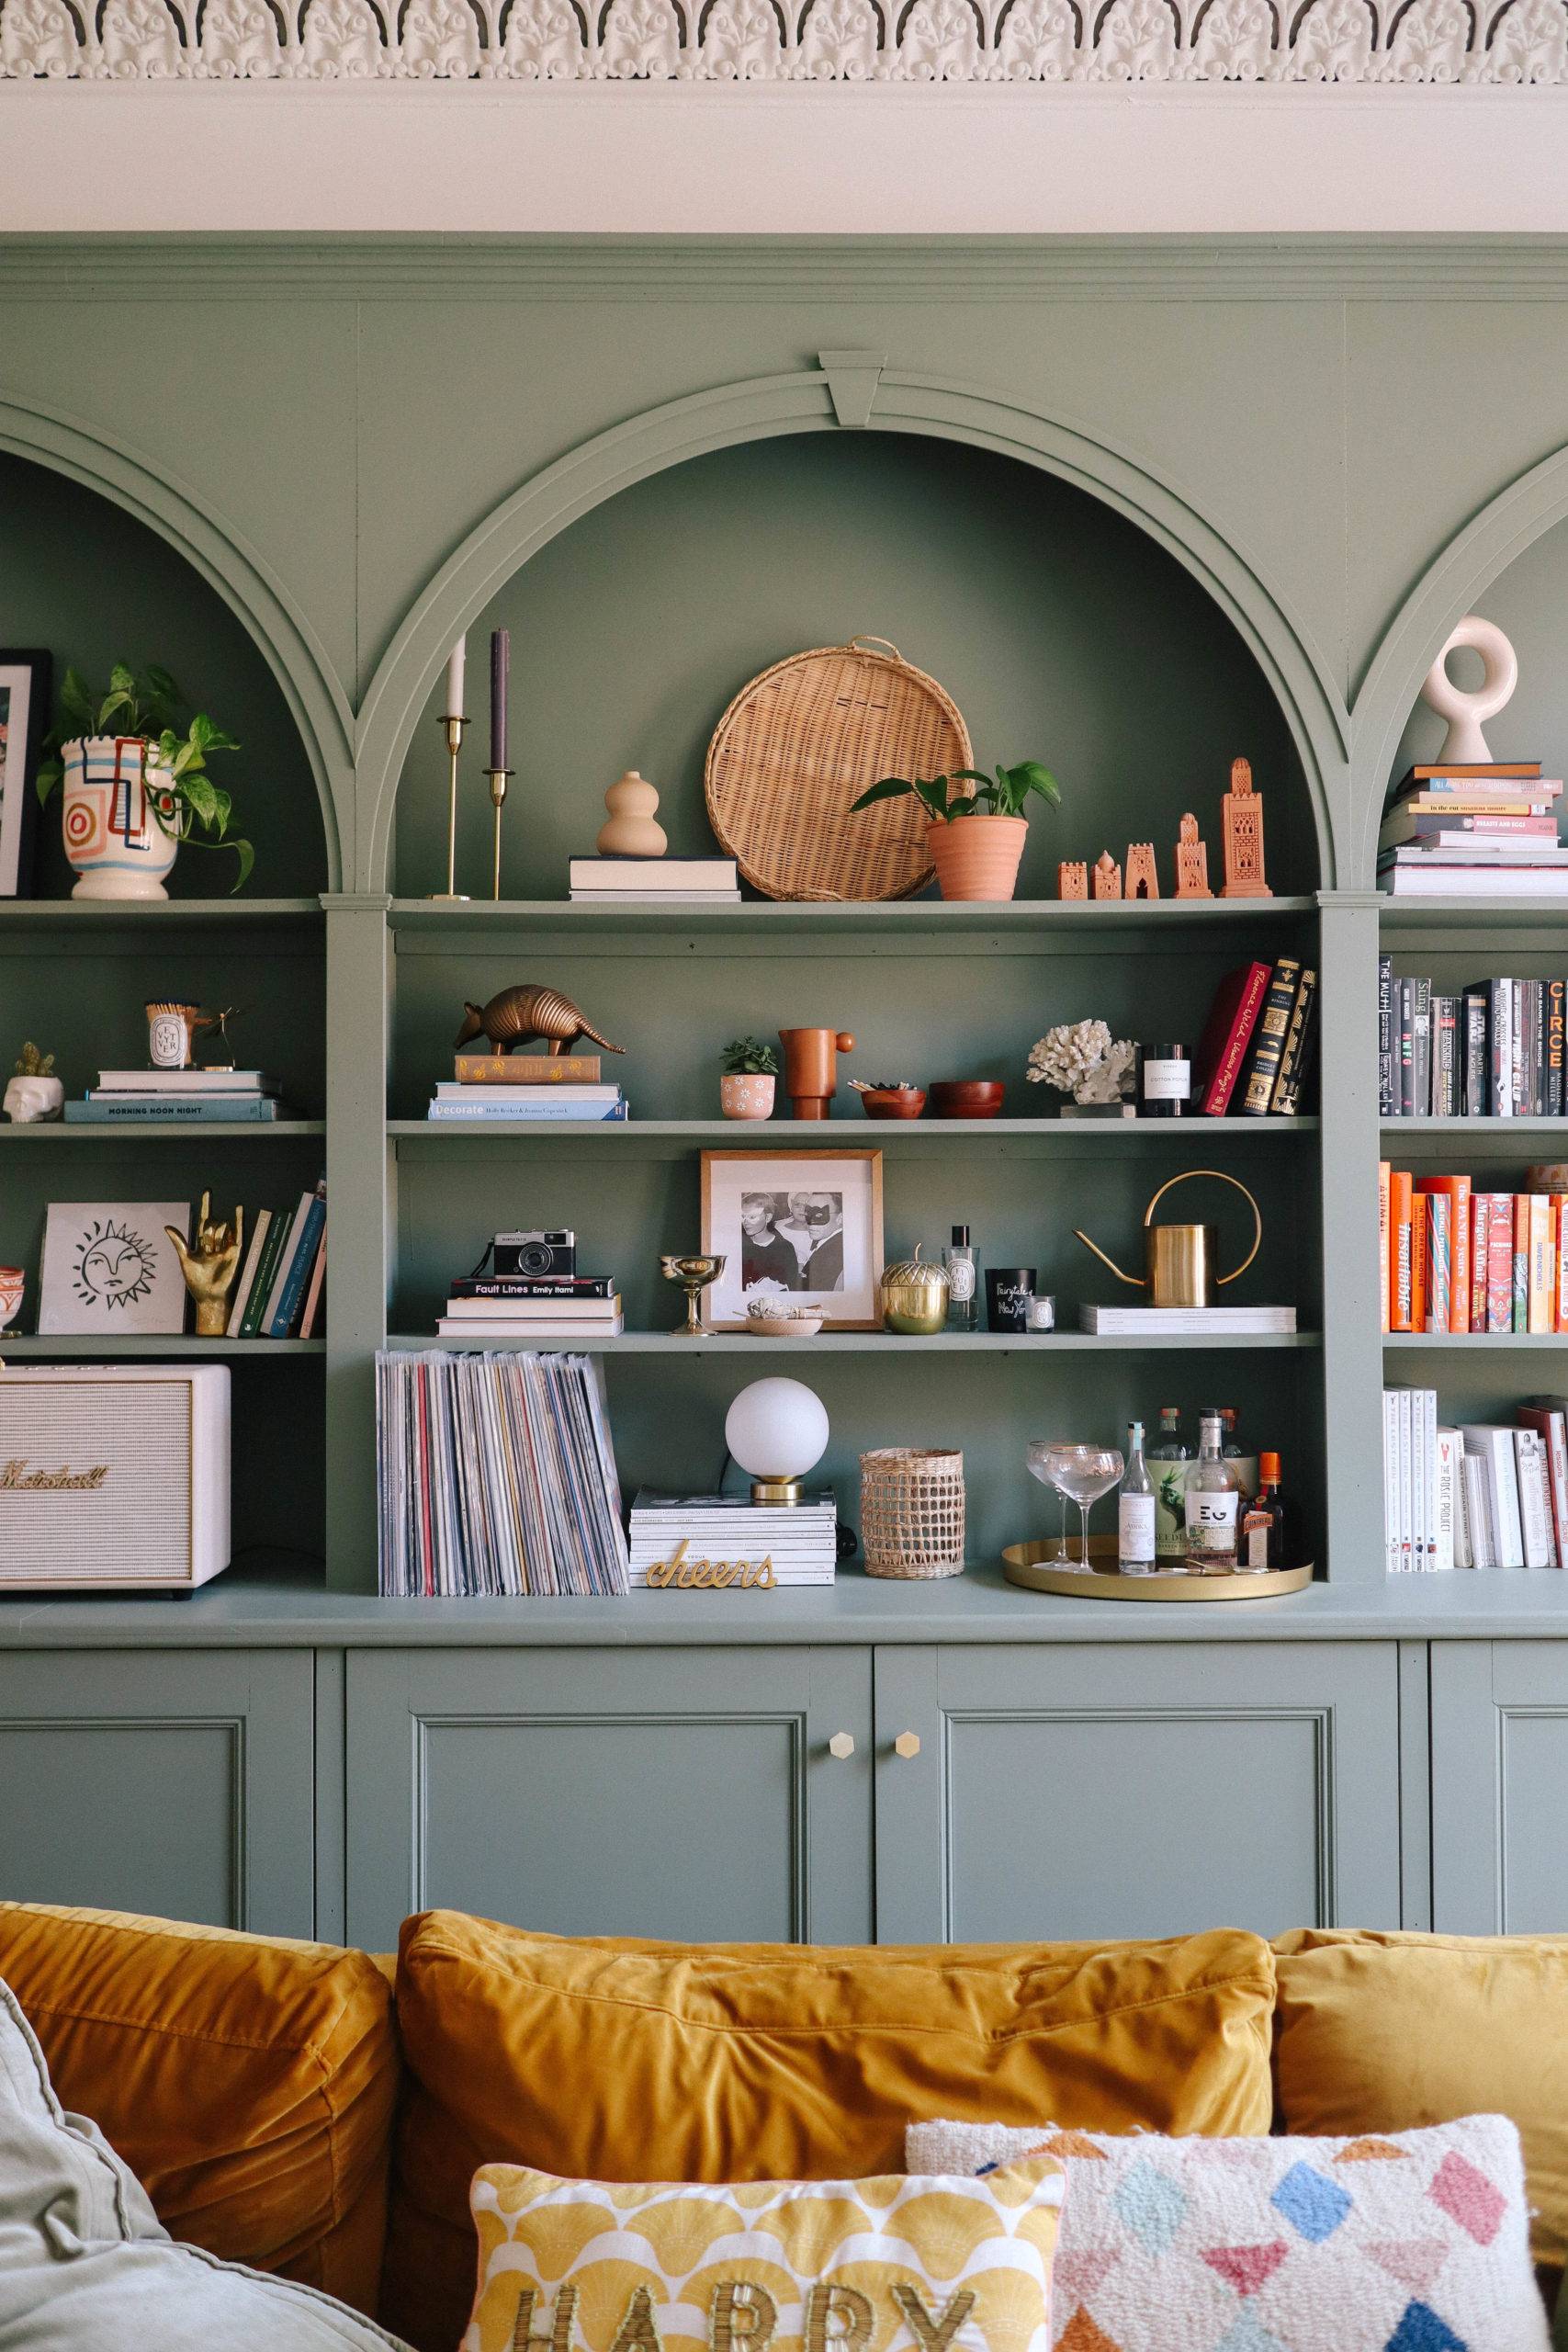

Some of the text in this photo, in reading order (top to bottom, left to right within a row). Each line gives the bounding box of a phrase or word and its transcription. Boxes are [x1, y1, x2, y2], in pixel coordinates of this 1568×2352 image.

[1512, 820, 1526, 829] EGGS
[1381, 960, 1391, 979] THE
[1247, 969, 1266, 1009] Florence
[1271, 998, 1291, 1006] BINDING
[1416, 982, 1427, 1012] Sting
[1236, 1008, 1252, 1038] Welch
[1470, 1012, 1478, 1044] WARS
[1477, 1013, 1485, 1043] STAR
[1550, 982, 1563, 1068] CIRCE
[1402, 1033, 1413, 1066] HWFG
[1442, 1030, 1452, 1069] MANKIND
[1218, 1069, 1233, 1093] Magic
[1513, 1036, 1521, 1102] FIGHT CLUB
[108, 1107, 147, 1115] MORNING
[435, 1104, 484, 1114] Decorate
[1418, 1204, 1425, 1213] IN
[1456, 1184, 1467, 1278] the PANIC years
[1475, 1203, 1487, 1246] Margot
[1398, 1224, 1411, 1310] insatiable
[1475, 1248, 1485, 1282] Affair
[475, 1284, 574, 1295] Fault Lines Emily Itami
[996, 1283, 1028, 1301] Fairytale
[998, 1300, 1014, 1315] New
[0, 1459, 109, 1490] Marshall
[1554, 1450, 1563, 1478] lessons
[1439, 1476, 1451, 1532] ROSIE PROJECT
[1459, 1476, 1467, 1511] ESPEDAIR
[1528, 1476, 1539, 1511] anthony
[1542, 1476, 1551, 1507] ATKINSON
[1200, 1506, 1227, 1521] EG
[1530, 1513, 1541, 1540] kiedis
[646, 1538, 779, 1589] cheers
